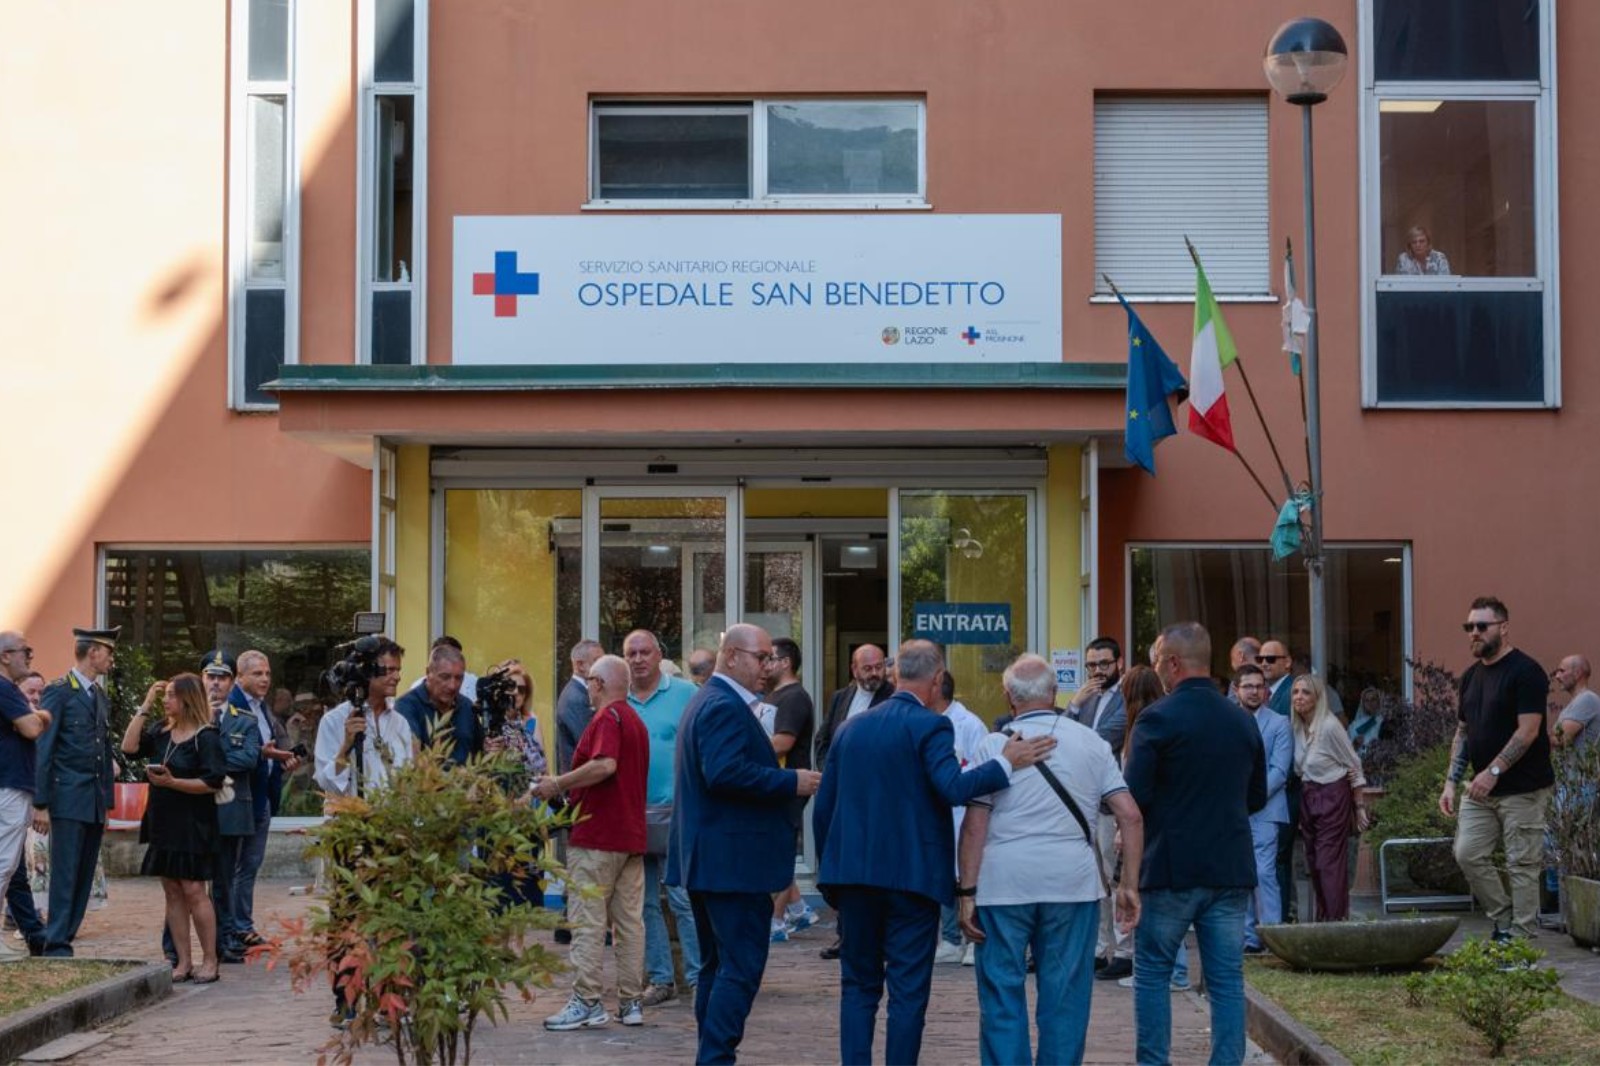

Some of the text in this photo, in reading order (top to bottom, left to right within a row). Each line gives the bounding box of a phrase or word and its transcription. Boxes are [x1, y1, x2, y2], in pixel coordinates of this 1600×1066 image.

[578, 259, 817, 274] SERVIZIO SANITARIO REGIONALE
[577, 281, 1006, 307] OSPEDALE SAN BENEDETTO
[904, 326, 948, 335] REGIONE
[904, 336, 936, 346] LAZIO
[916, 613, 1009, 632] ENTRATA
